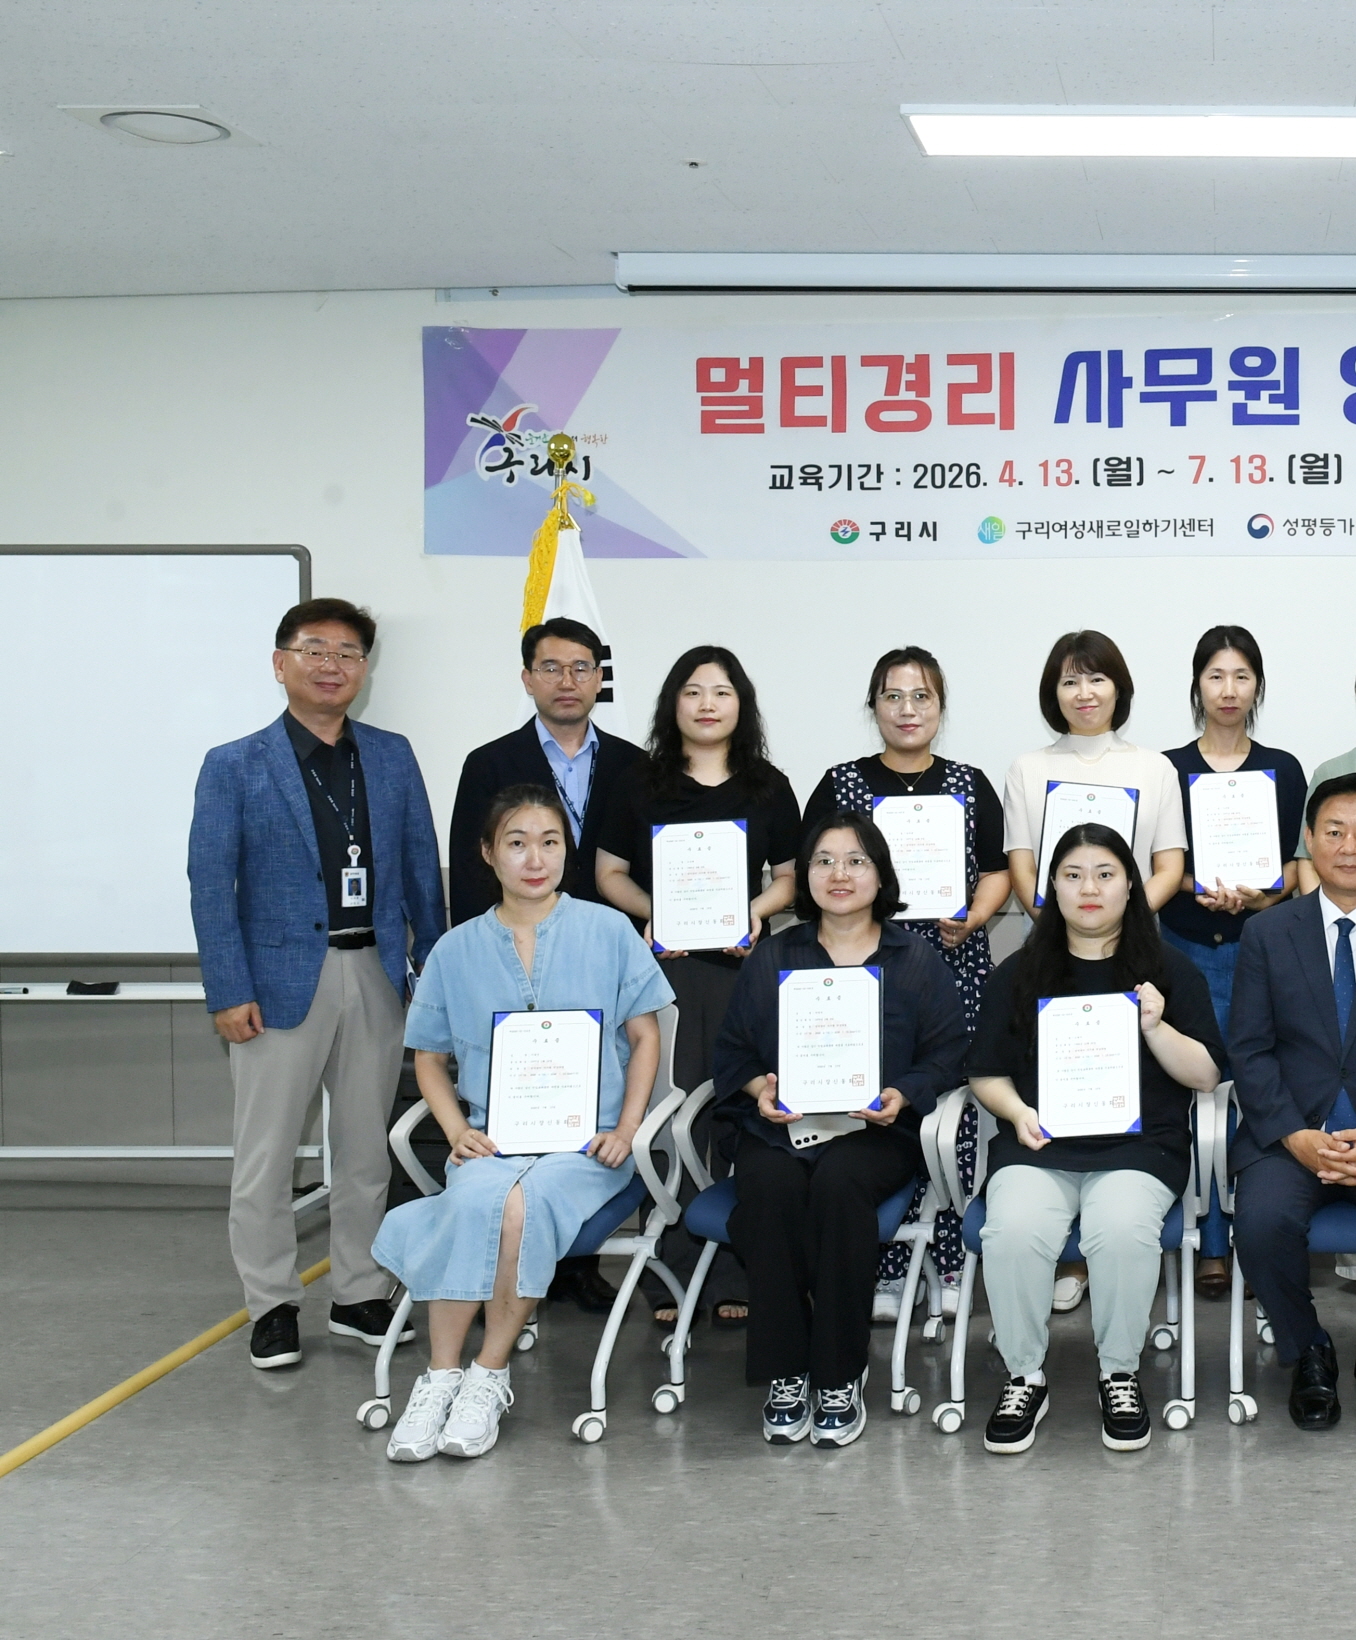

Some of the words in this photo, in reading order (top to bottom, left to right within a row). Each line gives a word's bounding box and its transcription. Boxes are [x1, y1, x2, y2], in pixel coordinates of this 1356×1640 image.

[695, 352, 1015, 434] 멀티경리
[1054, 346, 1300, 428] 사무원
[768, 462, 885, 492] 교육기간
[912, 462, 988, 490] 2026.
[998, 459, 1024, 488] 4.
[1038, 458, 1080, 487] 13.
[1188, 455, 1214, 485] 7.
[1229, 454, 1275, 485] 13.
[868, 520, 938, 542] 구리시
[1015, 517, 1214, 541] 구리여성새로일하기센터
